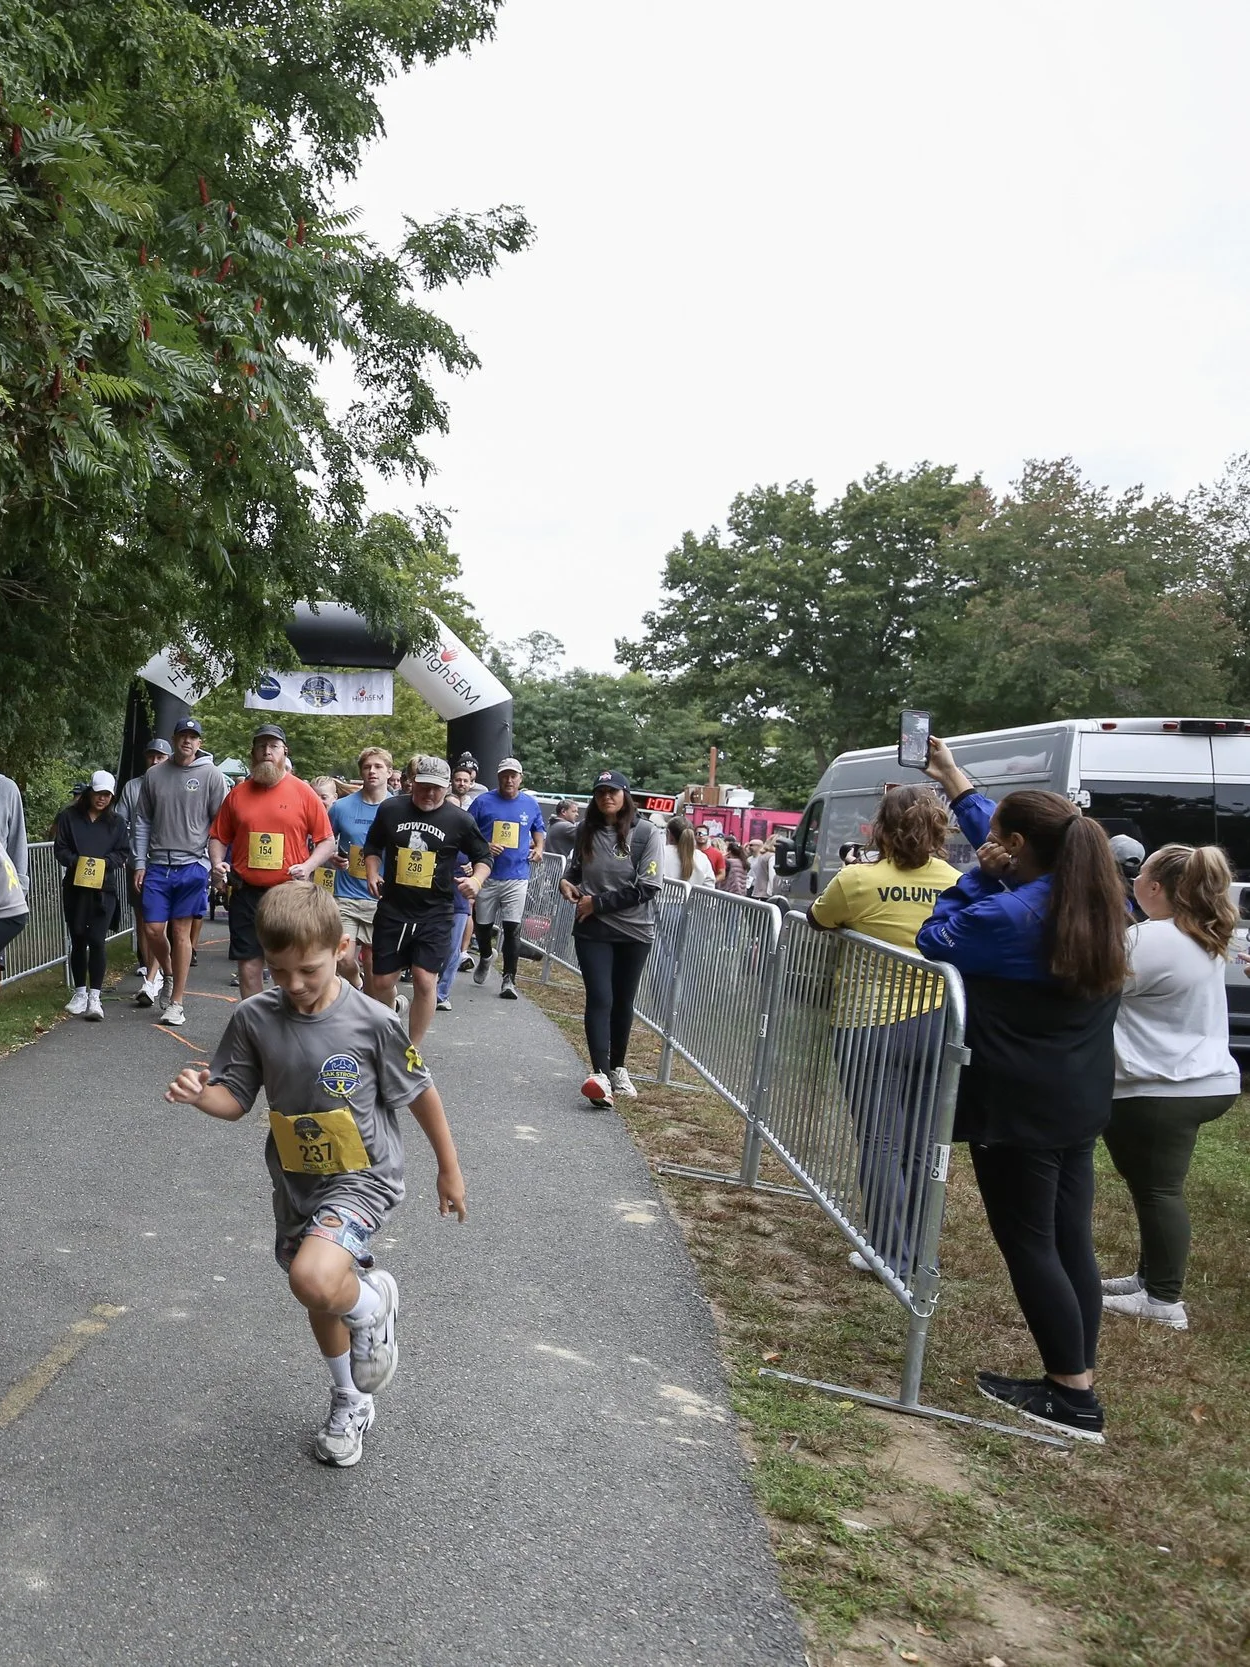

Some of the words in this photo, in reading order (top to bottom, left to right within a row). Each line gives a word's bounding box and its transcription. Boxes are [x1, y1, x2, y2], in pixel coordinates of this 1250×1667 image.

[646, 797, 674, 812] 1:00
[396, 821, 446, 842] BOWDOIN
[259, 845, 272, 855] 154
[83, 867, 96, 876] 284
[407, 862, 423, 873] 236
[322, 879, 333, 888] 155
[299, 1141, 332, 1163] 237
